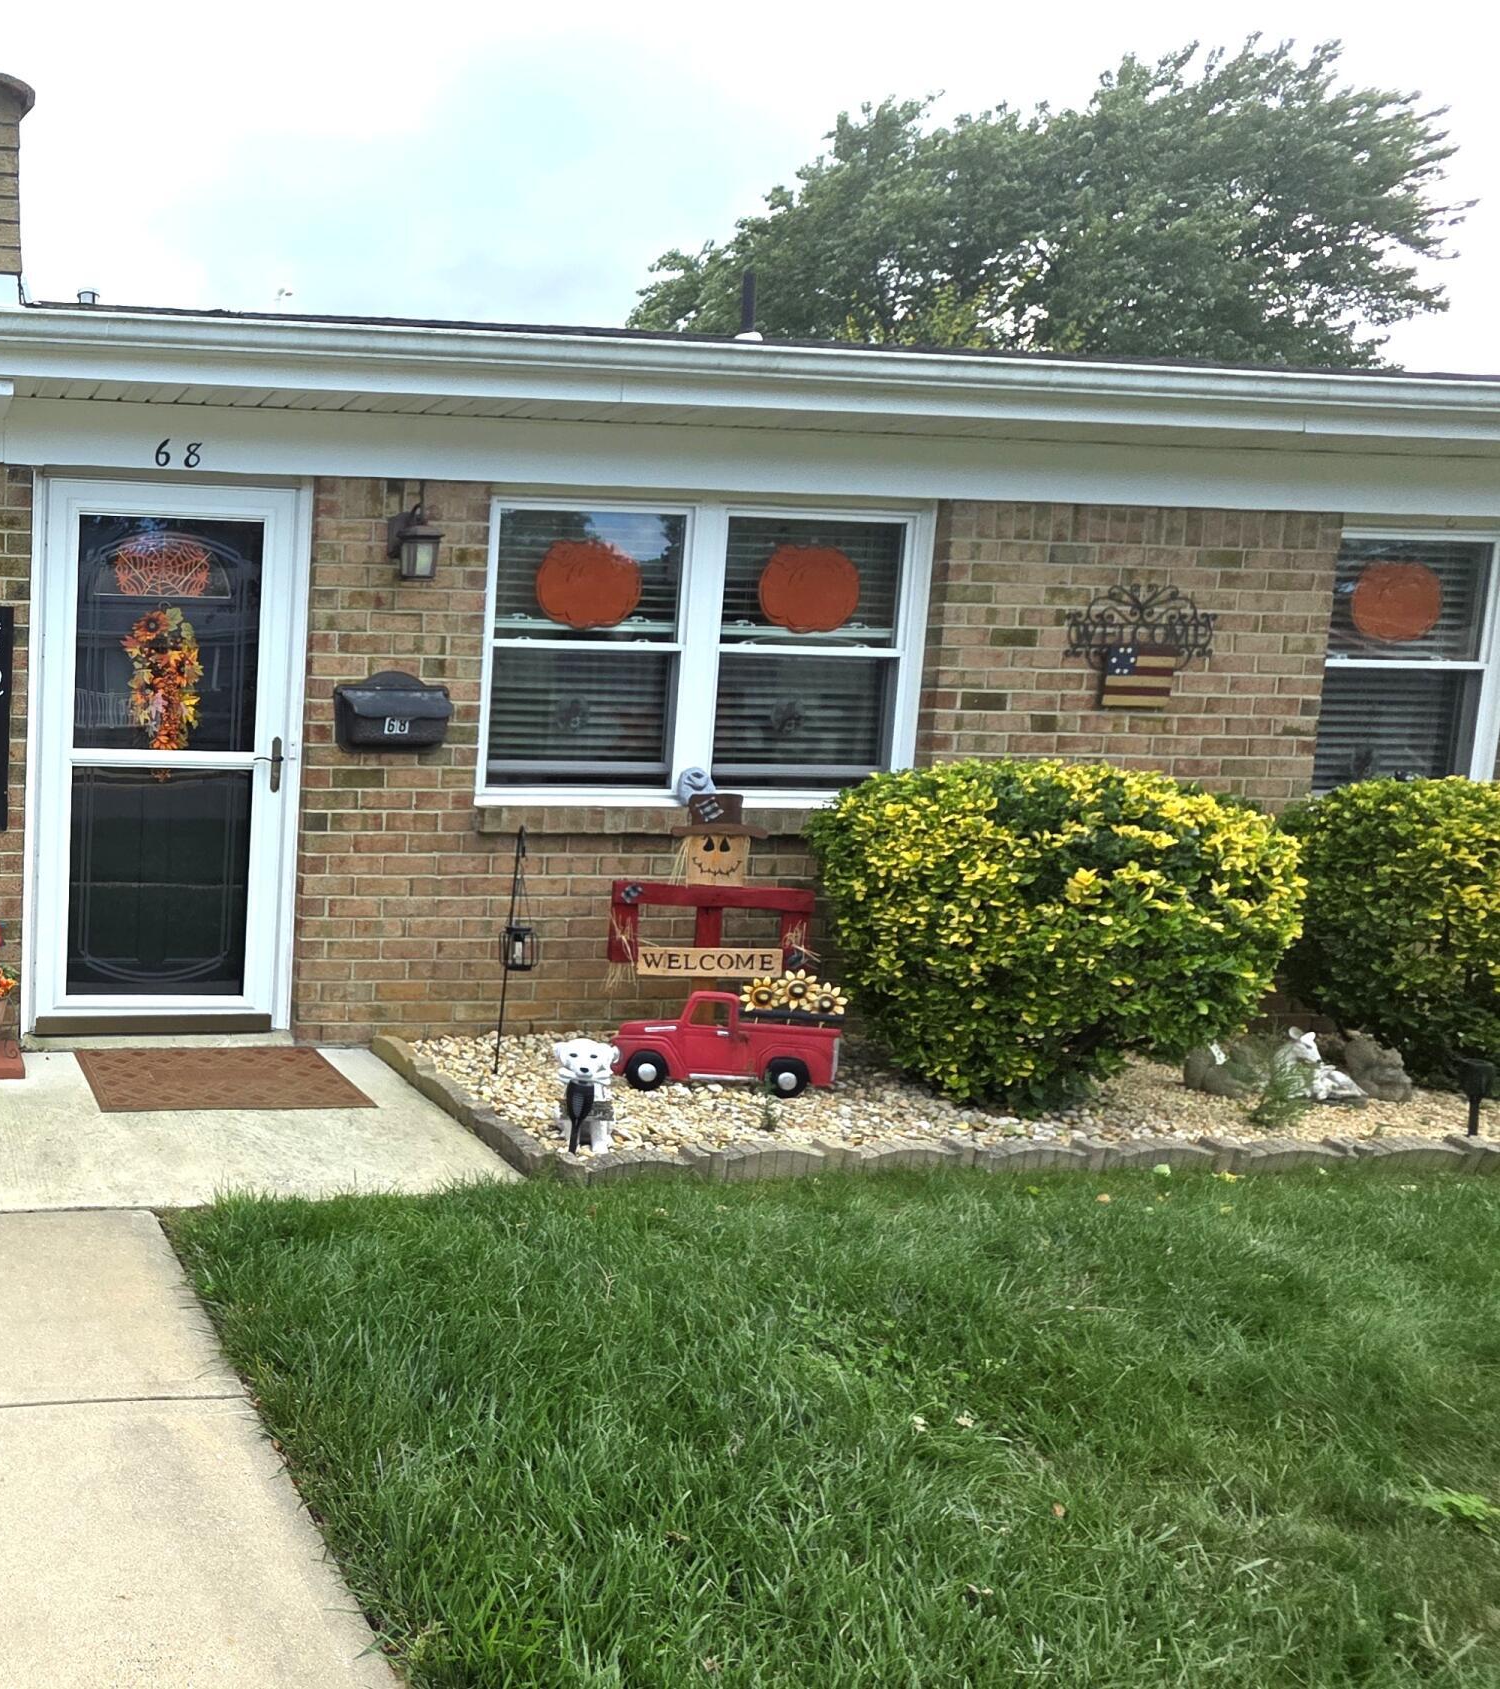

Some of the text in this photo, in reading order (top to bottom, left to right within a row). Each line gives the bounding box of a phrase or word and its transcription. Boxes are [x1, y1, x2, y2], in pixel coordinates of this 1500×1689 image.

[154, 438, 203, 468] 68
[387, 718, 407, 732] 68
[642, 953, 775, 971] WELCOME
